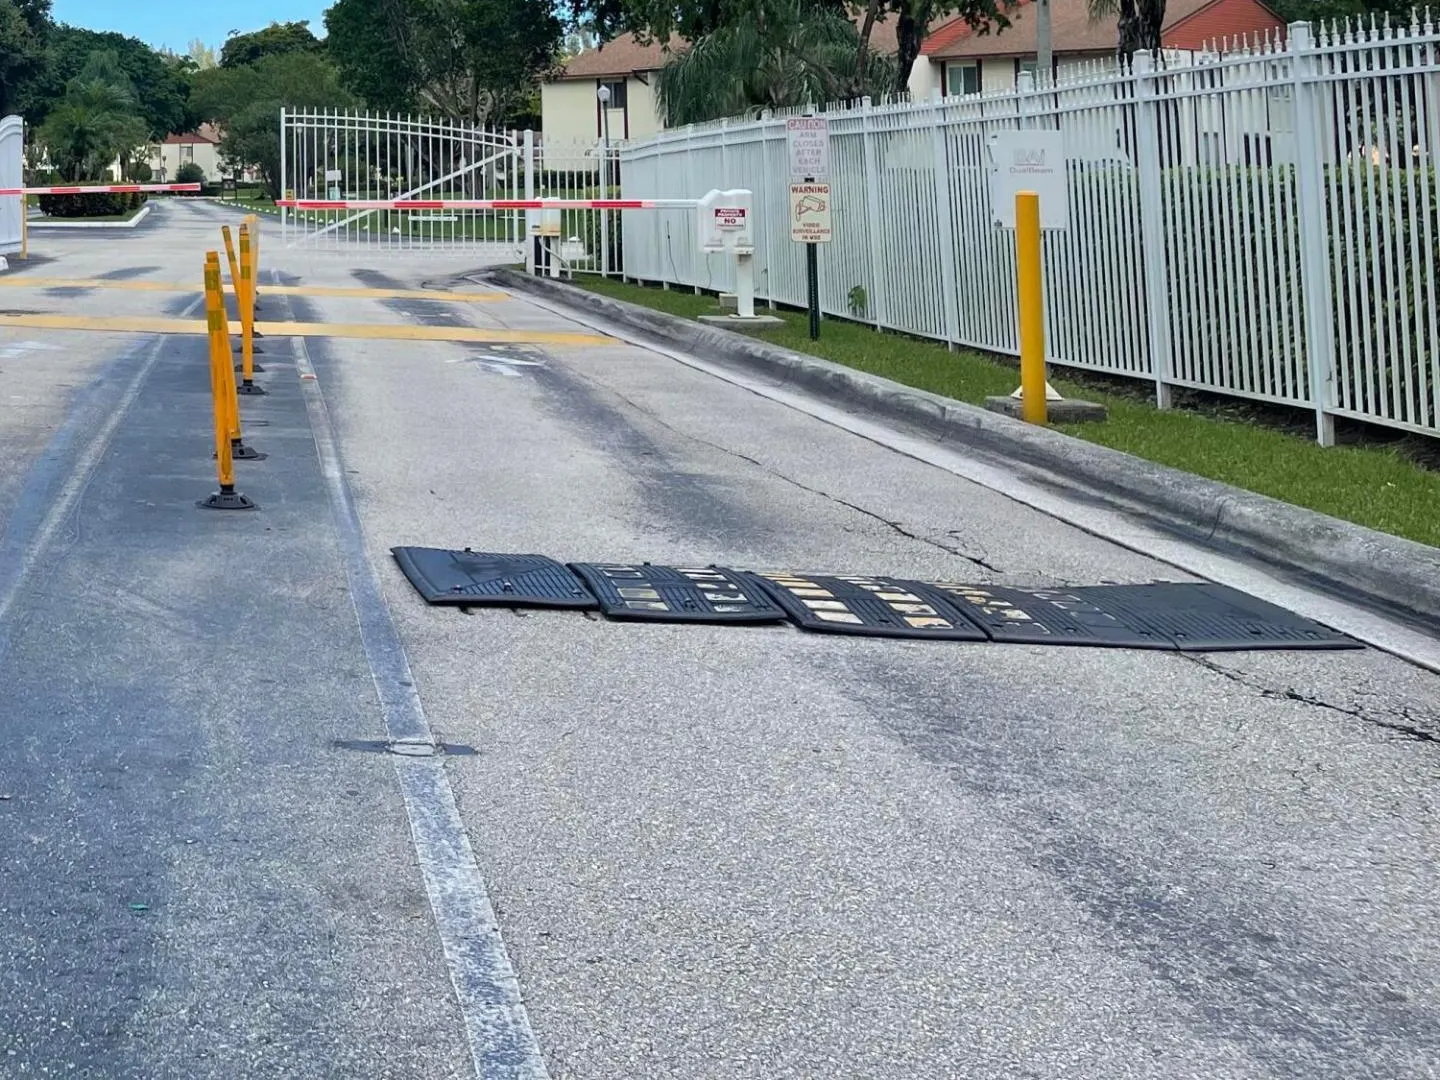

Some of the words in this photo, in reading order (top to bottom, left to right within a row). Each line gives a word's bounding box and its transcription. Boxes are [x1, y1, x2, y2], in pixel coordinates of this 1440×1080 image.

[788, 120, 826, 129] CAUTION
[793, 140, 824, 148] CLOSES
[798, 157, 820, 165] EACH
[791, 186, 829, 194] WARNING
